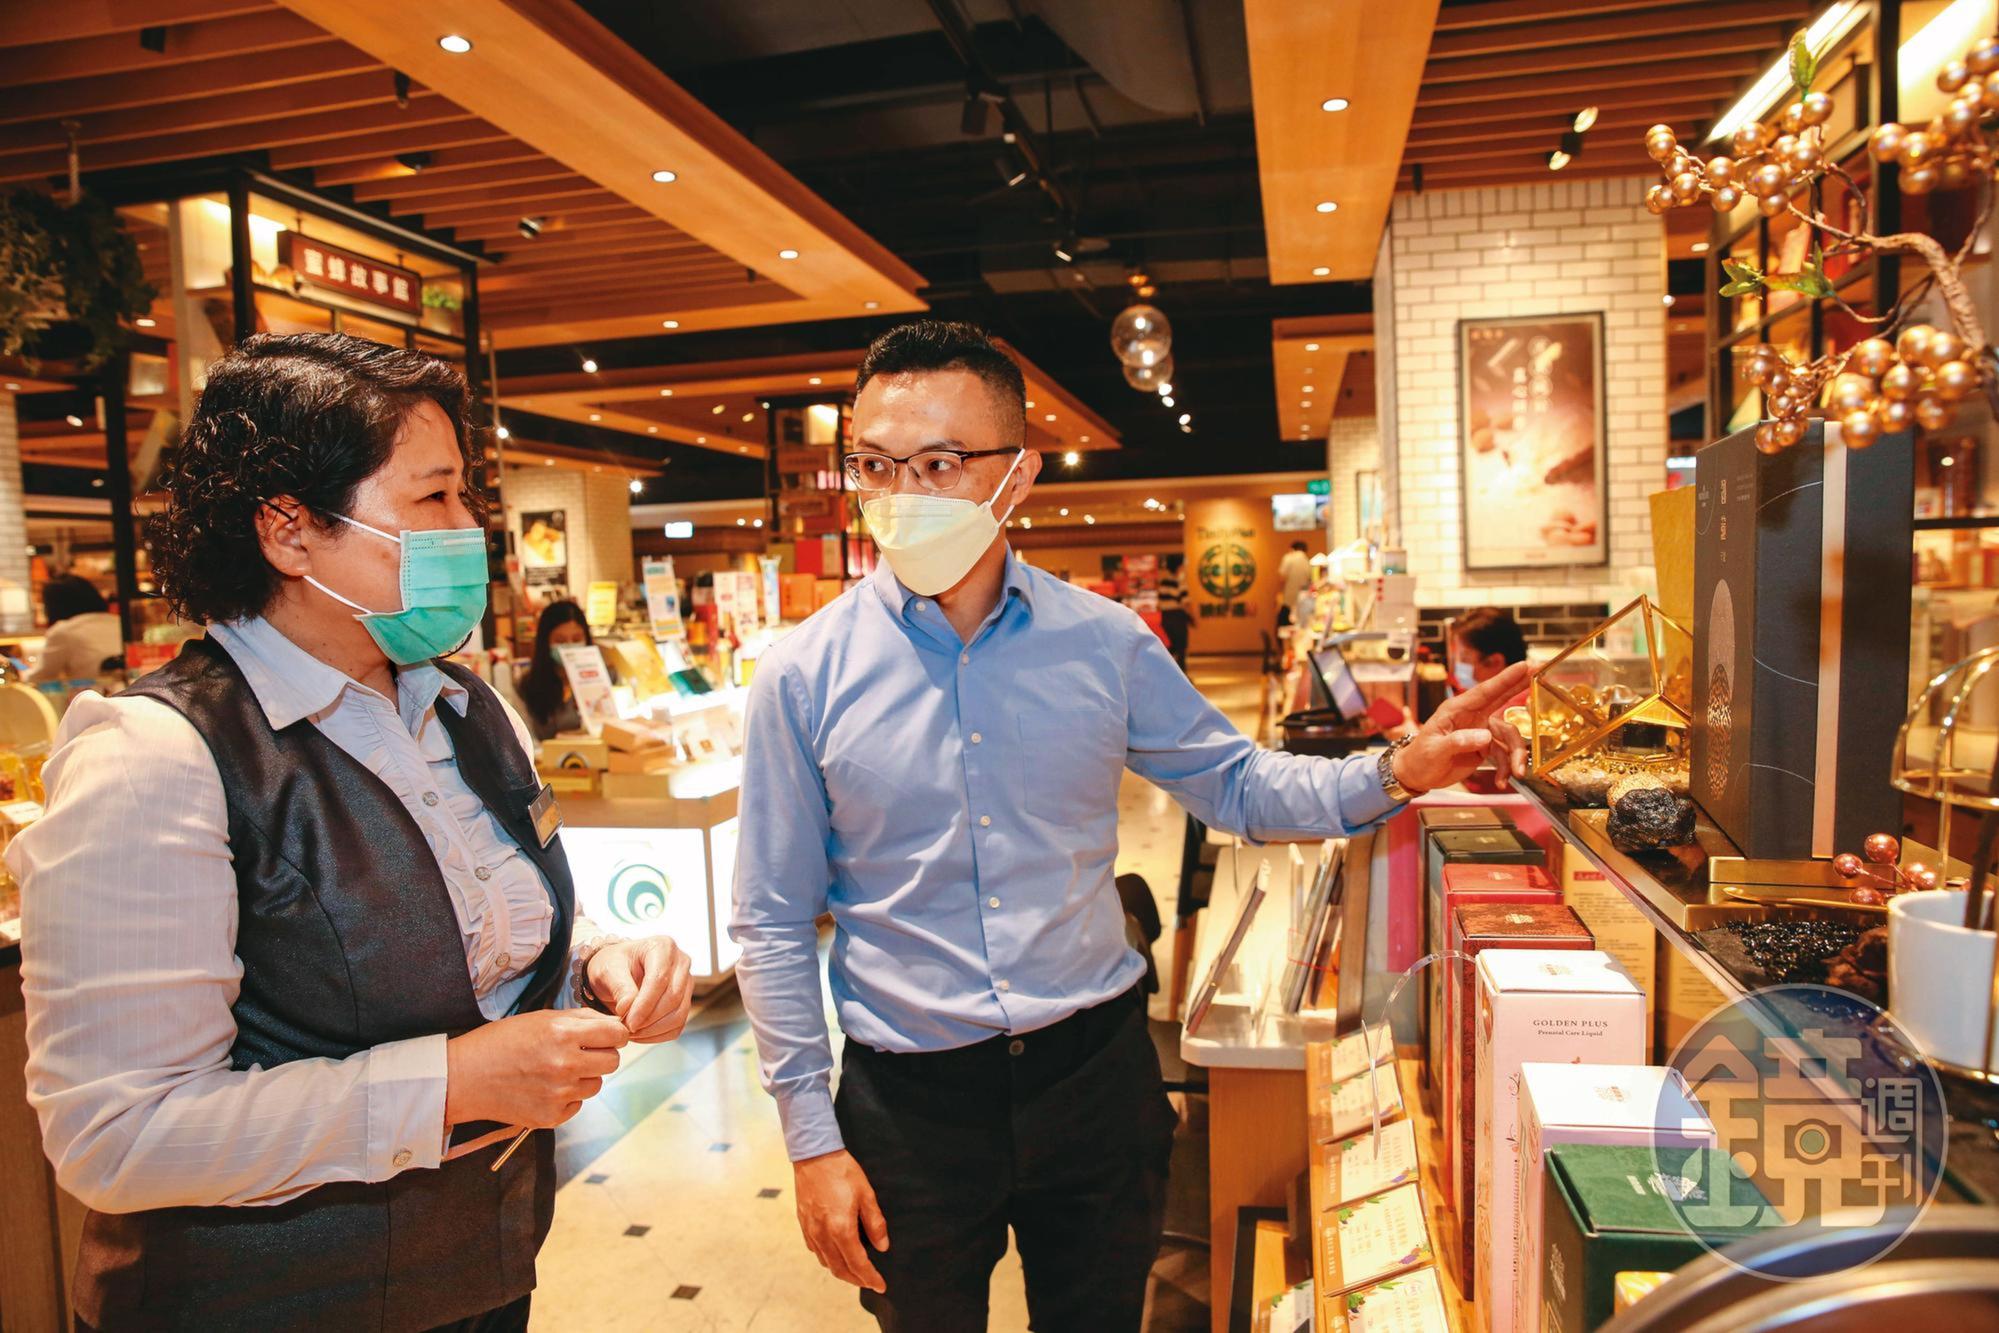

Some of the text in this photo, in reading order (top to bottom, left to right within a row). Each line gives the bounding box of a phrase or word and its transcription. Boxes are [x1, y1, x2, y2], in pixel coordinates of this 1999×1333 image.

[303, 248, 410, 303] 蜜蜂故事館
[1533, 1019, 1608, 1028] GOLDEN PLUS
[1581, 1030, 1603, 1038] Liquid
